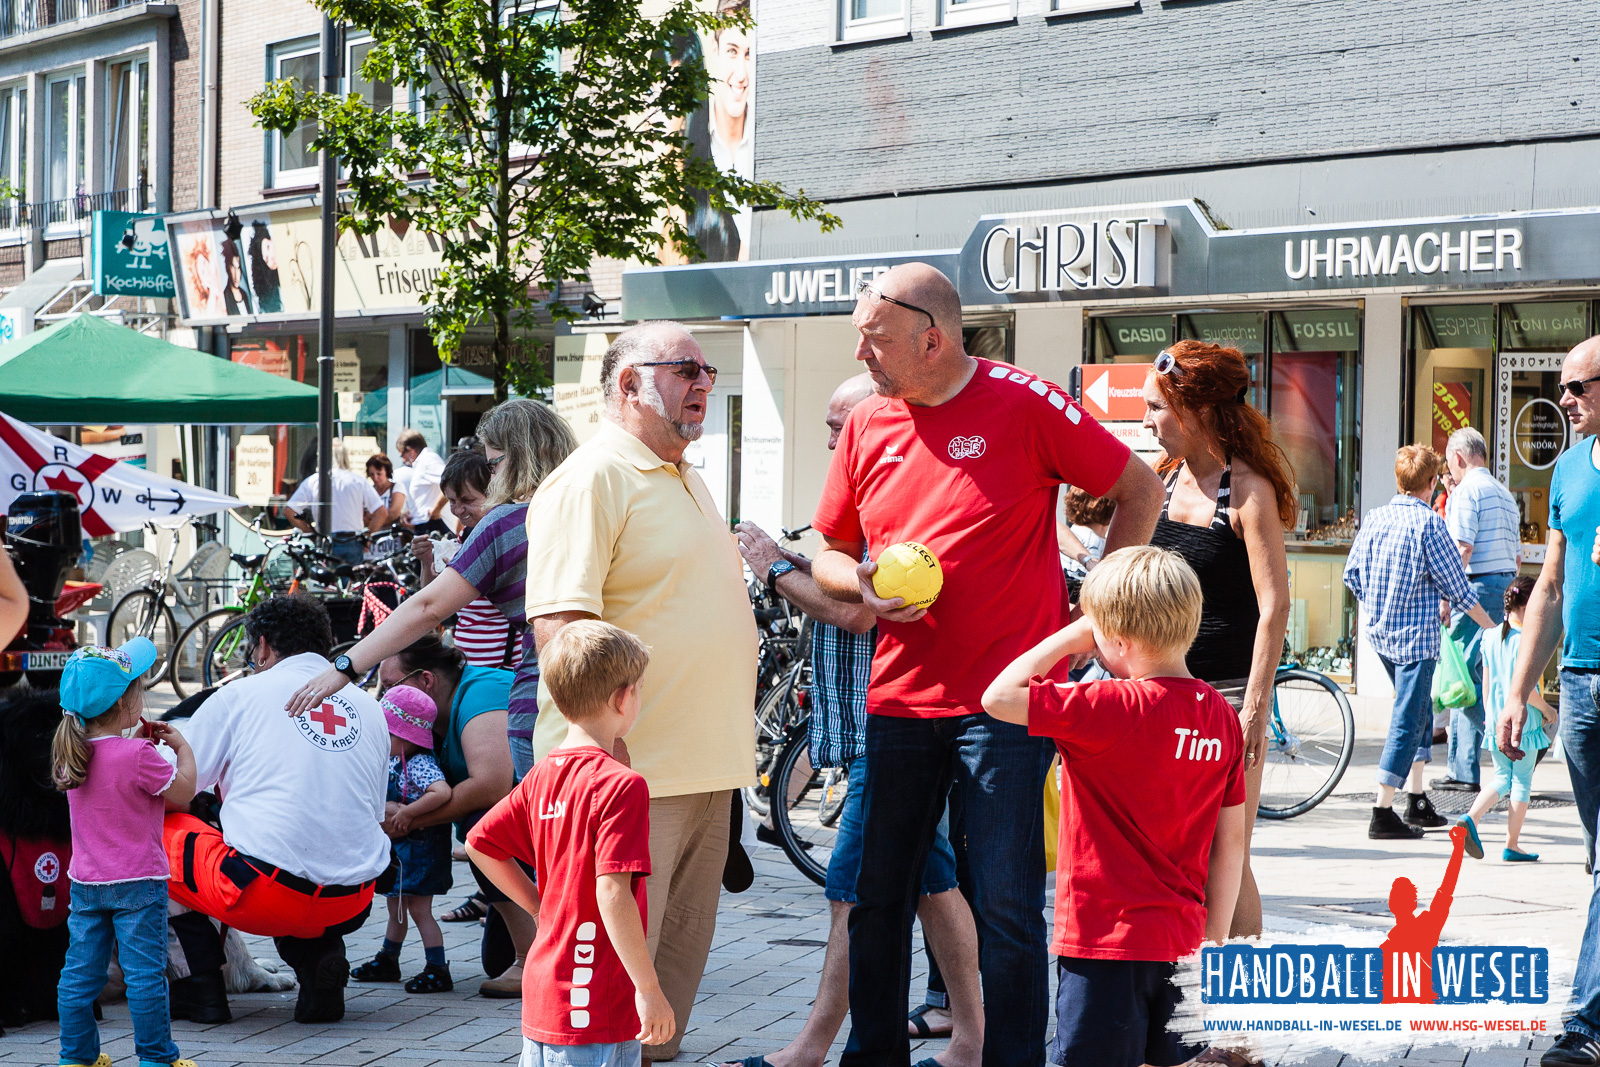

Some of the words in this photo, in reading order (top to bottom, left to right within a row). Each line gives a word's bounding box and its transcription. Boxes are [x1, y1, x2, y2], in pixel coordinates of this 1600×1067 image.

[980, 217, 1153, 294] CHRIST
[1285, 228, 1522, 281] UHRMACHER
[105, 274, 174, 293] Kochlöffe
[1293, 322, 1354, 338] FOSSIL
[1435, 316, 1490, 336] ESPRIT
[1511, 318, 1547, 331] TONI
[1551, 316, 1586, 330] GAR
[1118, 327, 1166, 343] CASIO
[54, 446, 68, 462] R
[11, 473, 27, 492] G
[102, 488, 122, 504] W
[298, 716, 327, 746] ROTES
[332, 726, 358, 748] KREUZ
[1174, 727, 1222, 761] Tim
